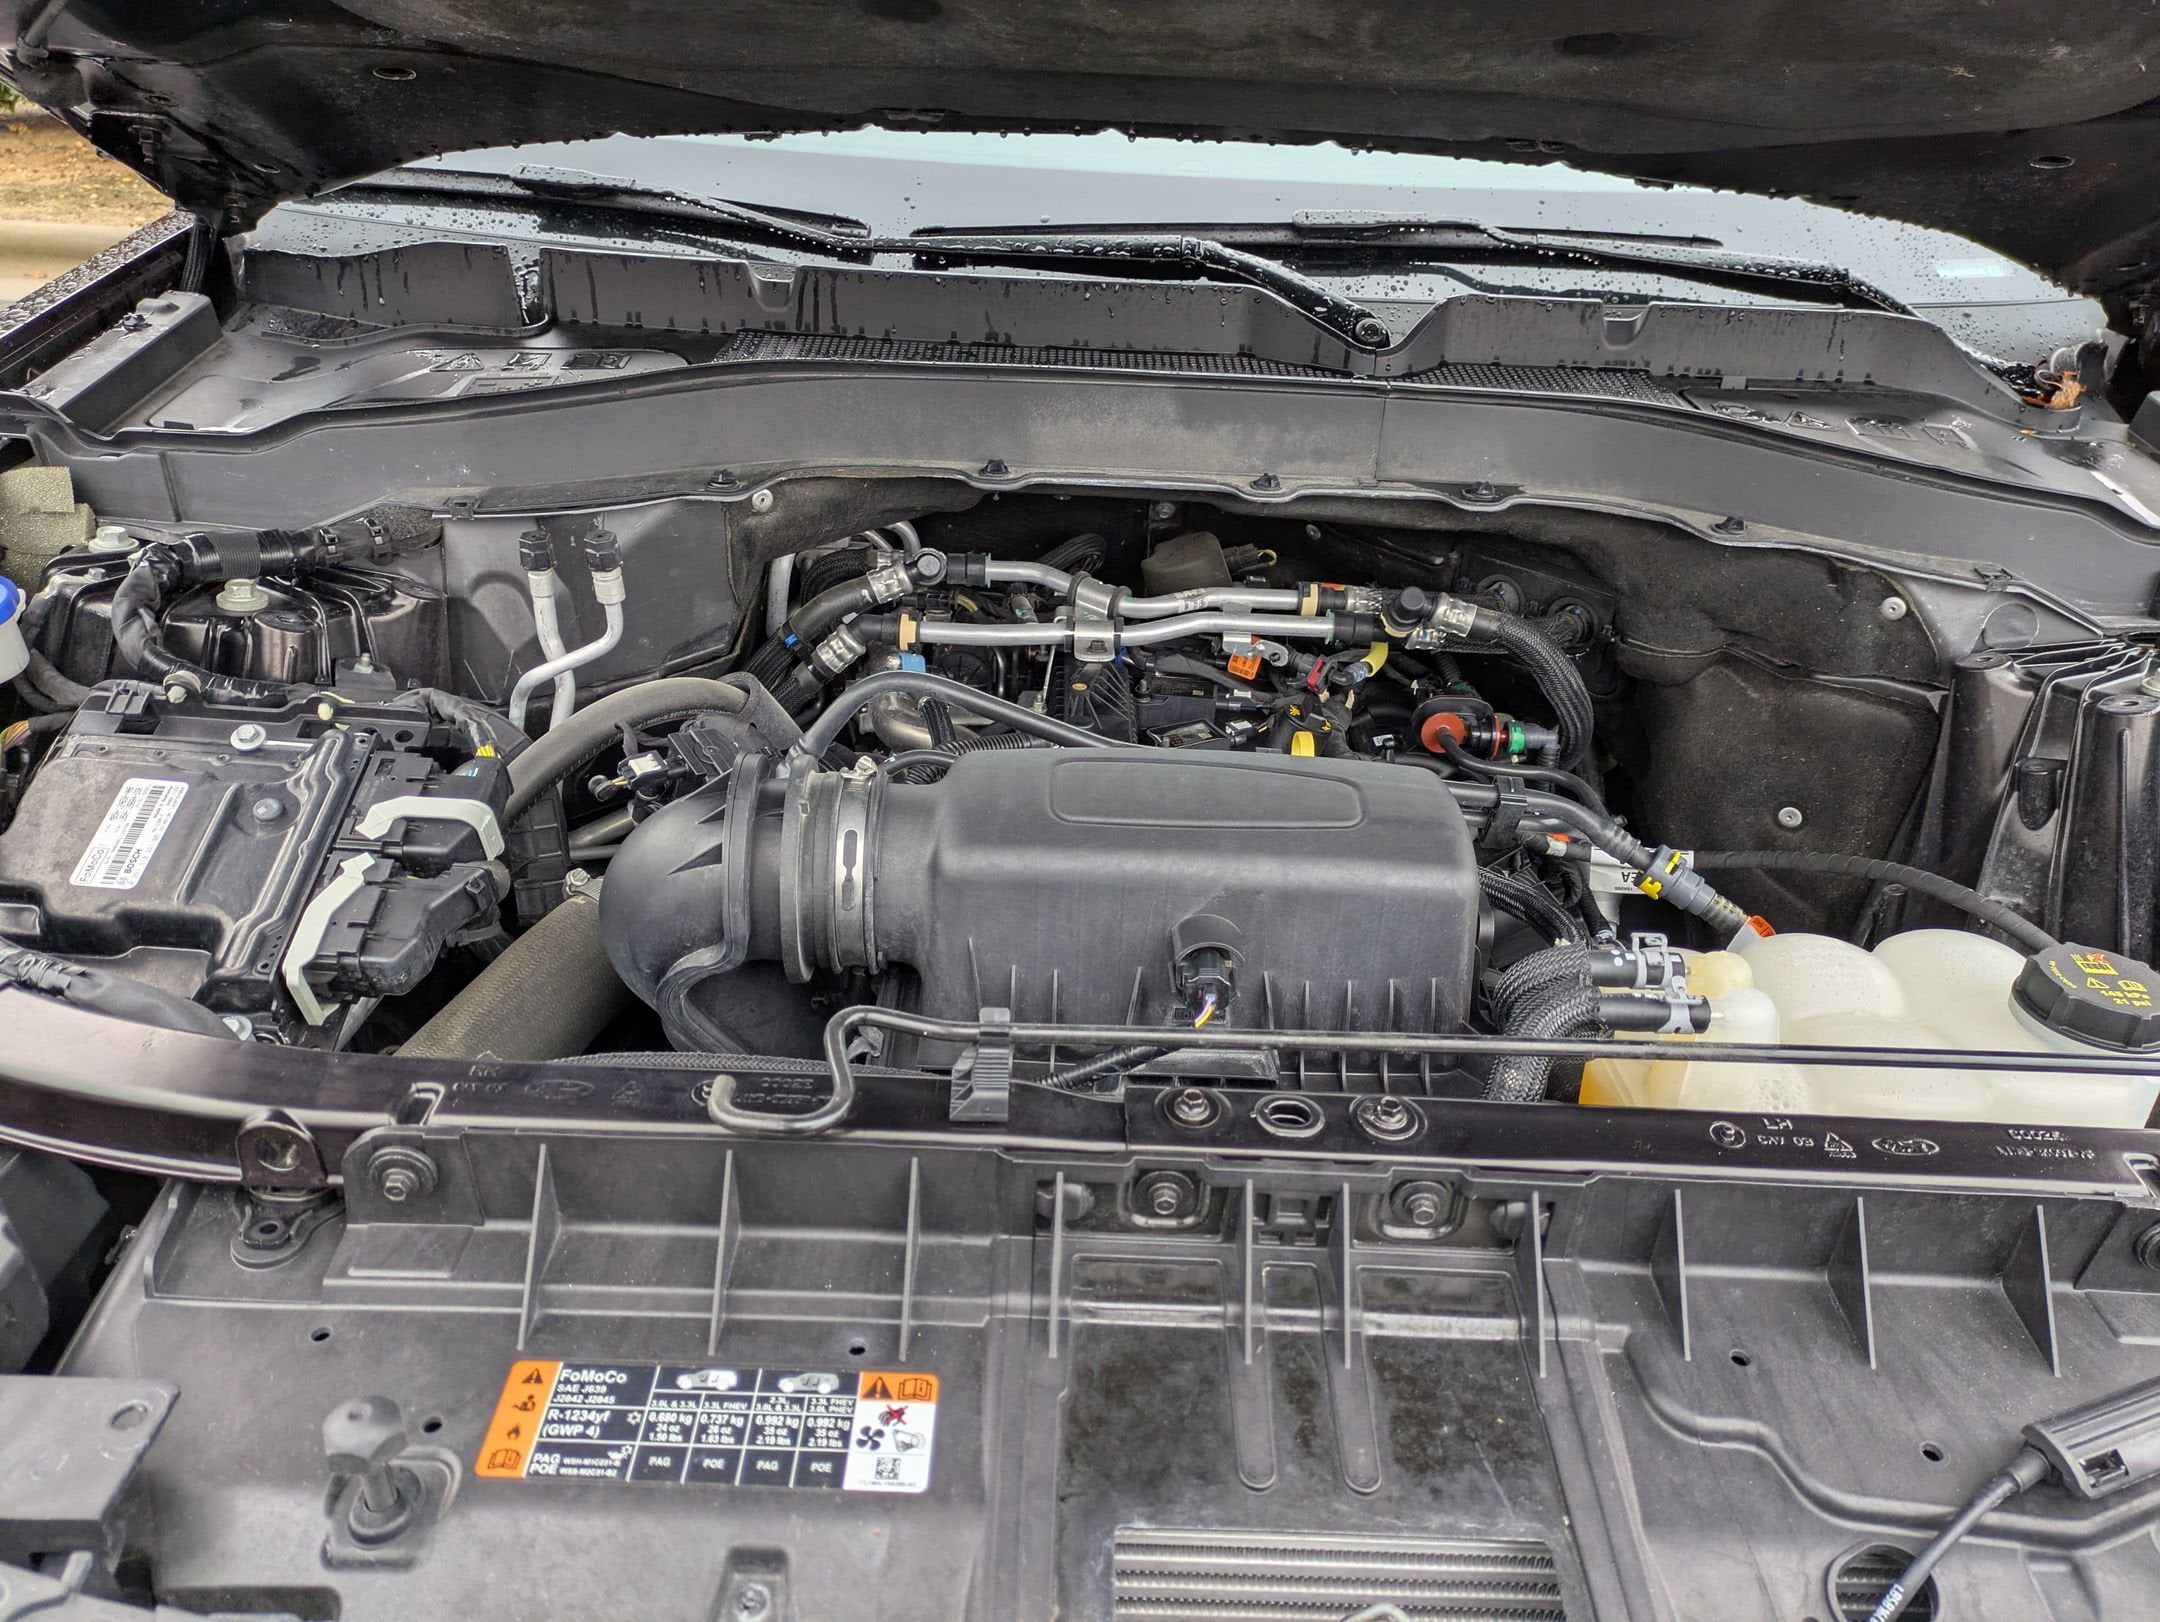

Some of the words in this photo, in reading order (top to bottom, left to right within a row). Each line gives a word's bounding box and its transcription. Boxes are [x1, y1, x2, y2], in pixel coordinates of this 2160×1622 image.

[80, 849, 104, 882] FoMoCo
[124, 849, 142, 874] BOSCH
[1761, 1117, 1794, 1130] LH
[560, 1369, 627, 1384] FoMoCo
[556, 1384, 580, 1393] SAE
[547, 1408, 611, 1424] R-1234yf
[678, 1412, 693, 1426] kg
[700, 1413, 729, 1425] 0.737
[730, 1414, 744, 1428] kg
[656, 1423, 668, 1432] 24
[668, 1425, 680, 1433] oz
[785, 1416, 800, 1430] kg
[836, 1418, 850, 1432] kg
[542, 1424, 584, 1438] (GWP
[585, 1425, 600, 1438] 4)
[720, 1426, 732, 1435] oz
[776, 1428, 788, 1436] oz
[828, 1430, 840, 1438] oz
[668, 1432, 684, 1442] lbs
[720, 1434, 735, 1444] lbs
[776, 1436, 792, 1446] lbs
[828, 1438, 843, 1448] lbs
[533, 1453, 560, 1464] PAG
[648, 1456, 671, 1467] PAG
[702, 1458, 726, 1469] POE
[529, 1462, 559, 1475] POE
[756, 1460, 779, 1471] PAG
[810, 1461, 833, 1473] POE
